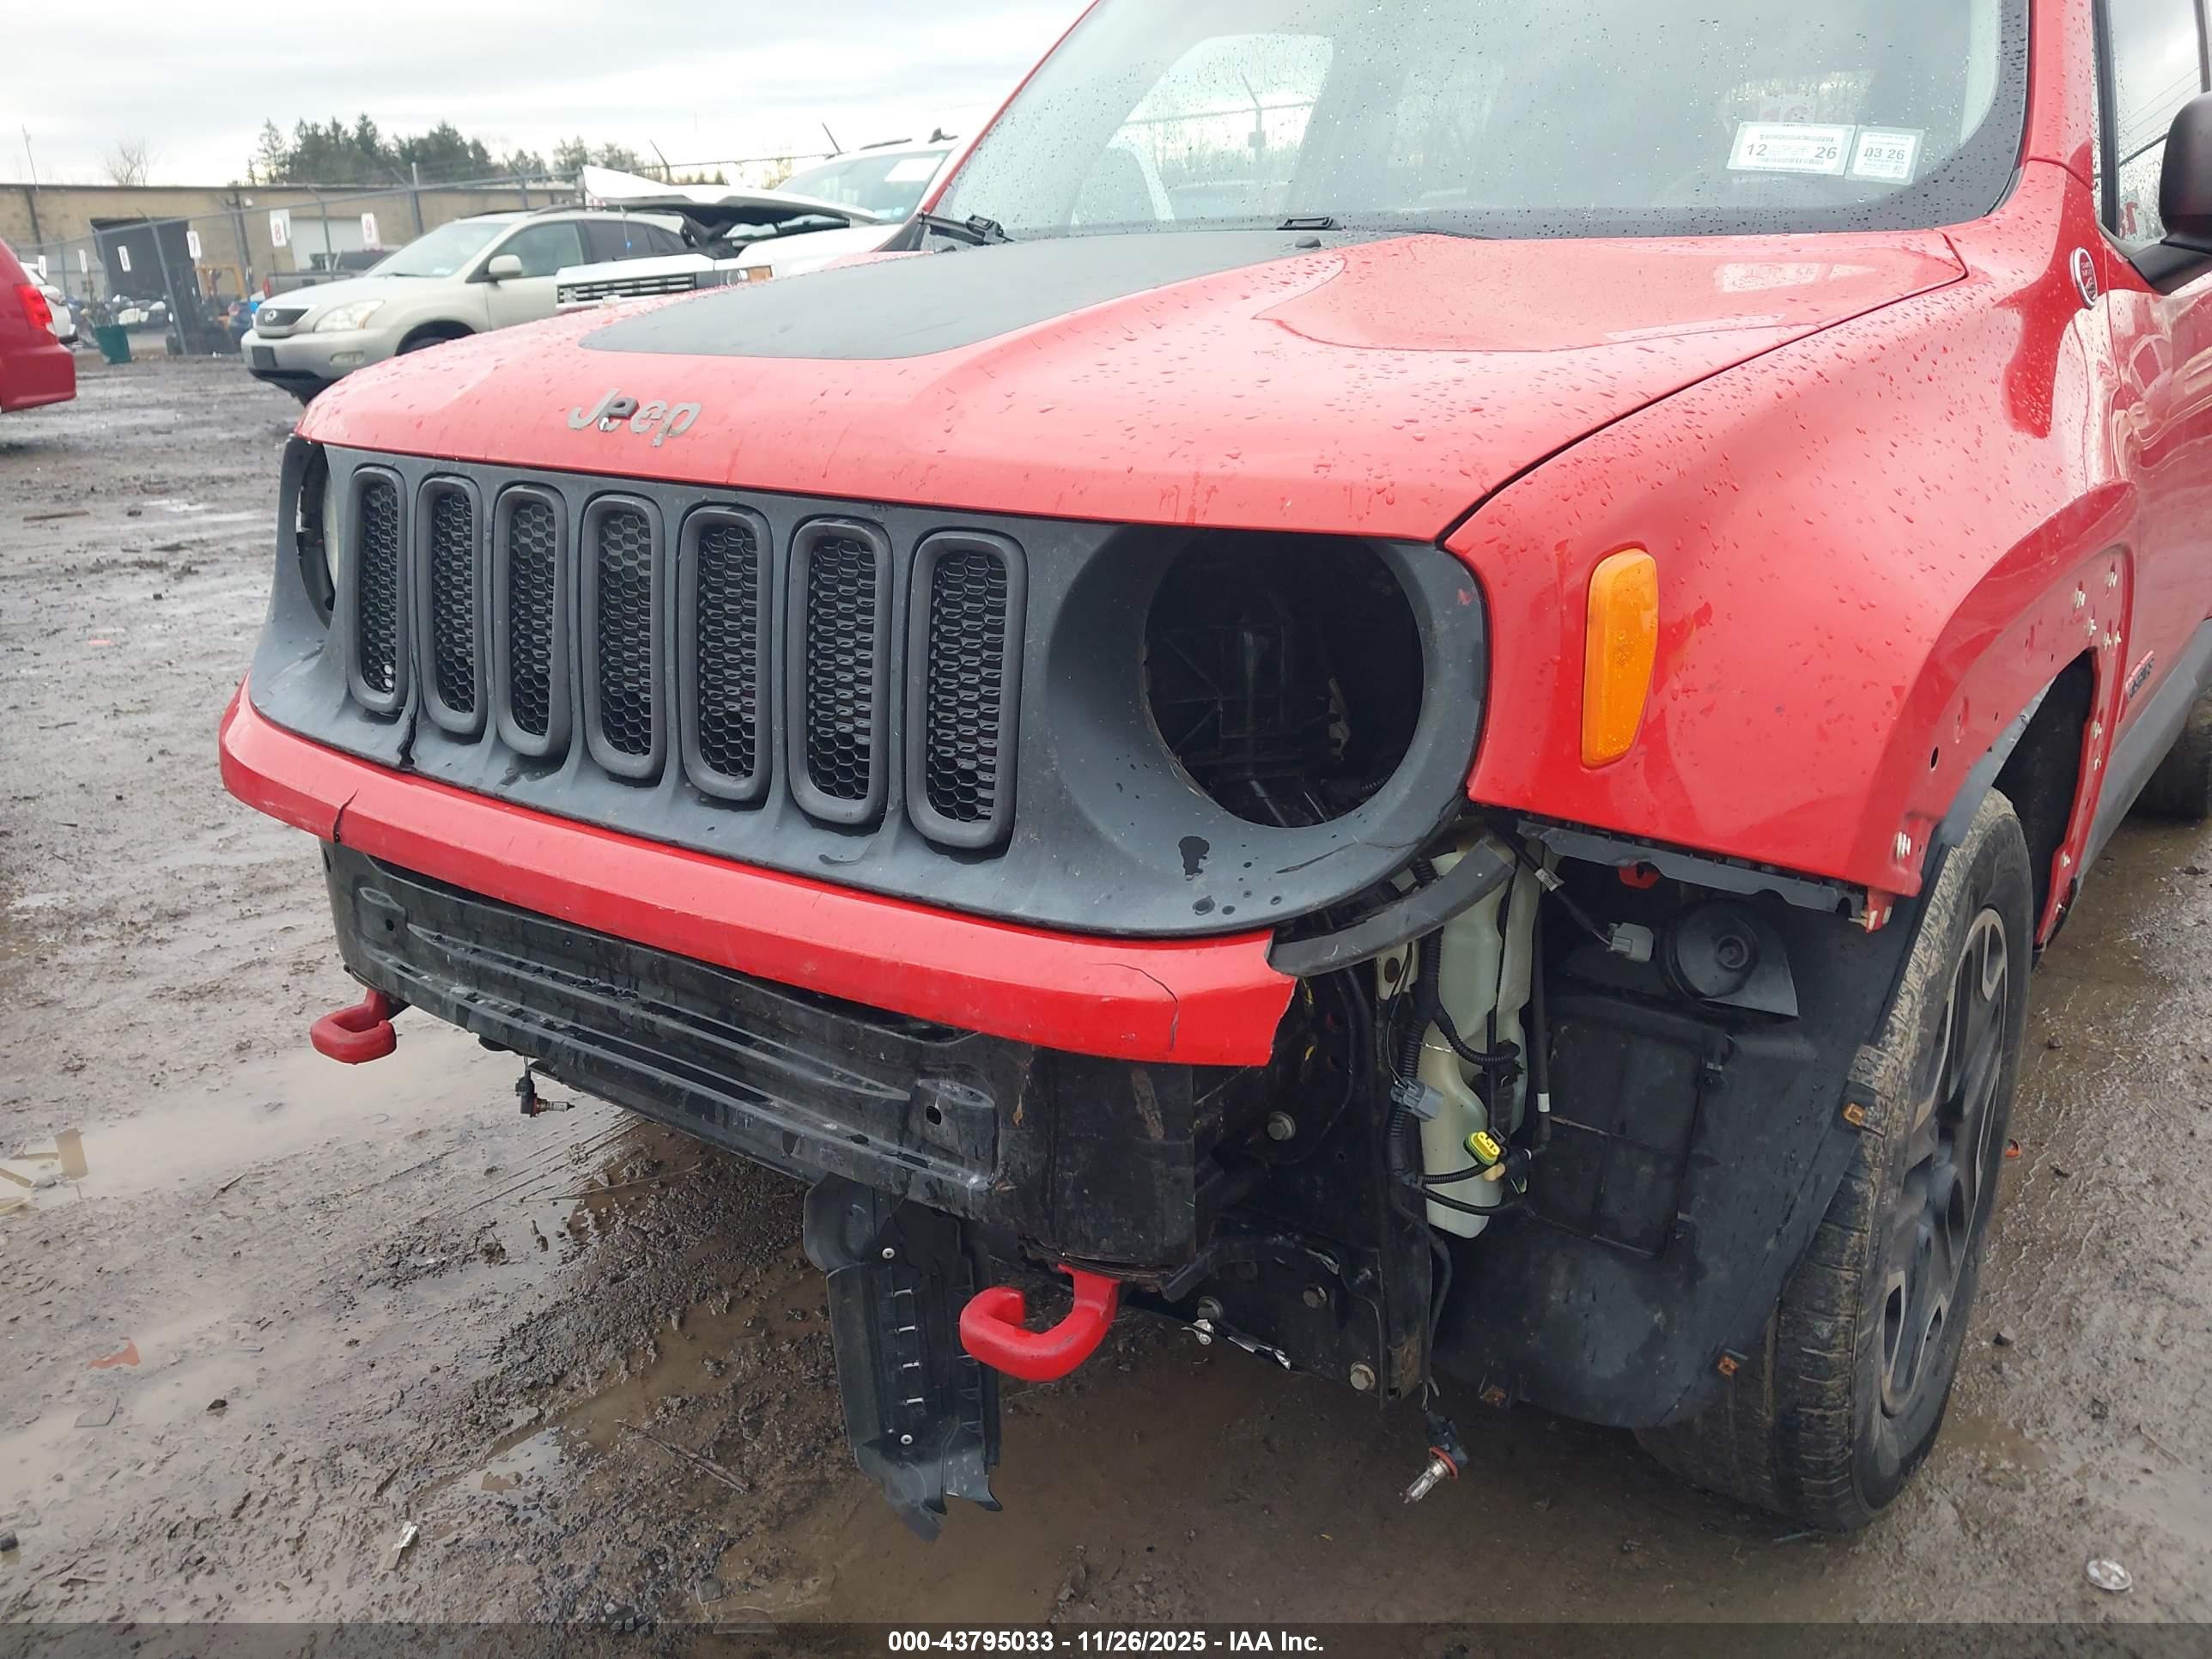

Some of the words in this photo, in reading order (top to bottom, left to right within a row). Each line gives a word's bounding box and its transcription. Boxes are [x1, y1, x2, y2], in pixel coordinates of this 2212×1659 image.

[1746, 143, 1768, 156] 12
[1814, 146, 1838, 160] 26
[1863, 146, 1883, 158] 03
[1887, 149, 1905, 160] 26
[565, 387, 702, 448] Jeep
